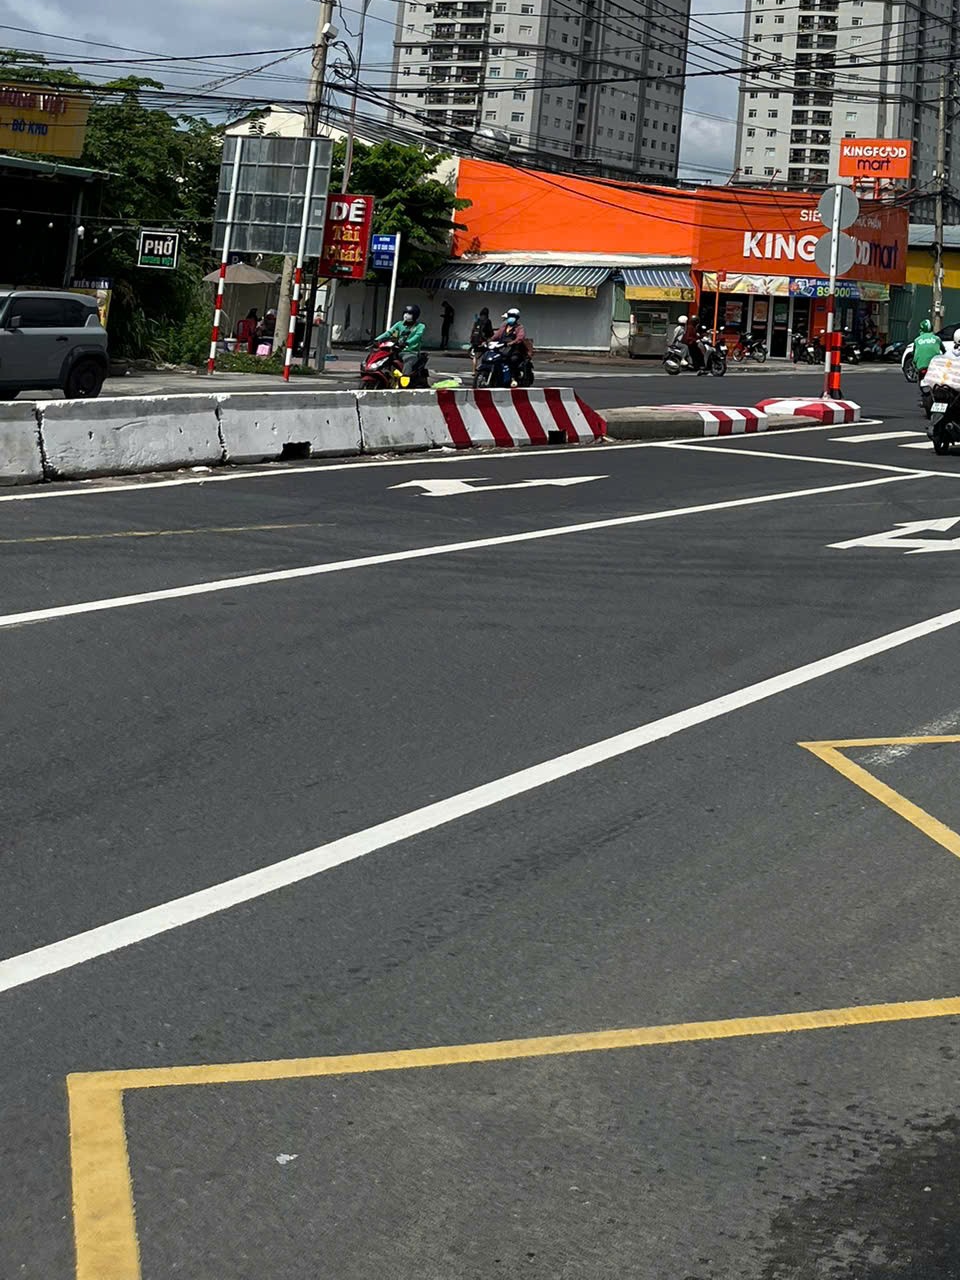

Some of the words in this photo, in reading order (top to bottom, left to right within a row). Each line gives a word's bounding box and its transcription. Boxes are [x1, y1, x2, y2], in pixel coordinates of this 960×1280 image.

[843, 146, 907, 158] KINGFOOD
[857, 158, 891, 171] mart
[329, 198, 366, 223] DÊ
[144, 236, 174, 255] PHỞ
[917, 337, 936, 345] Grab
